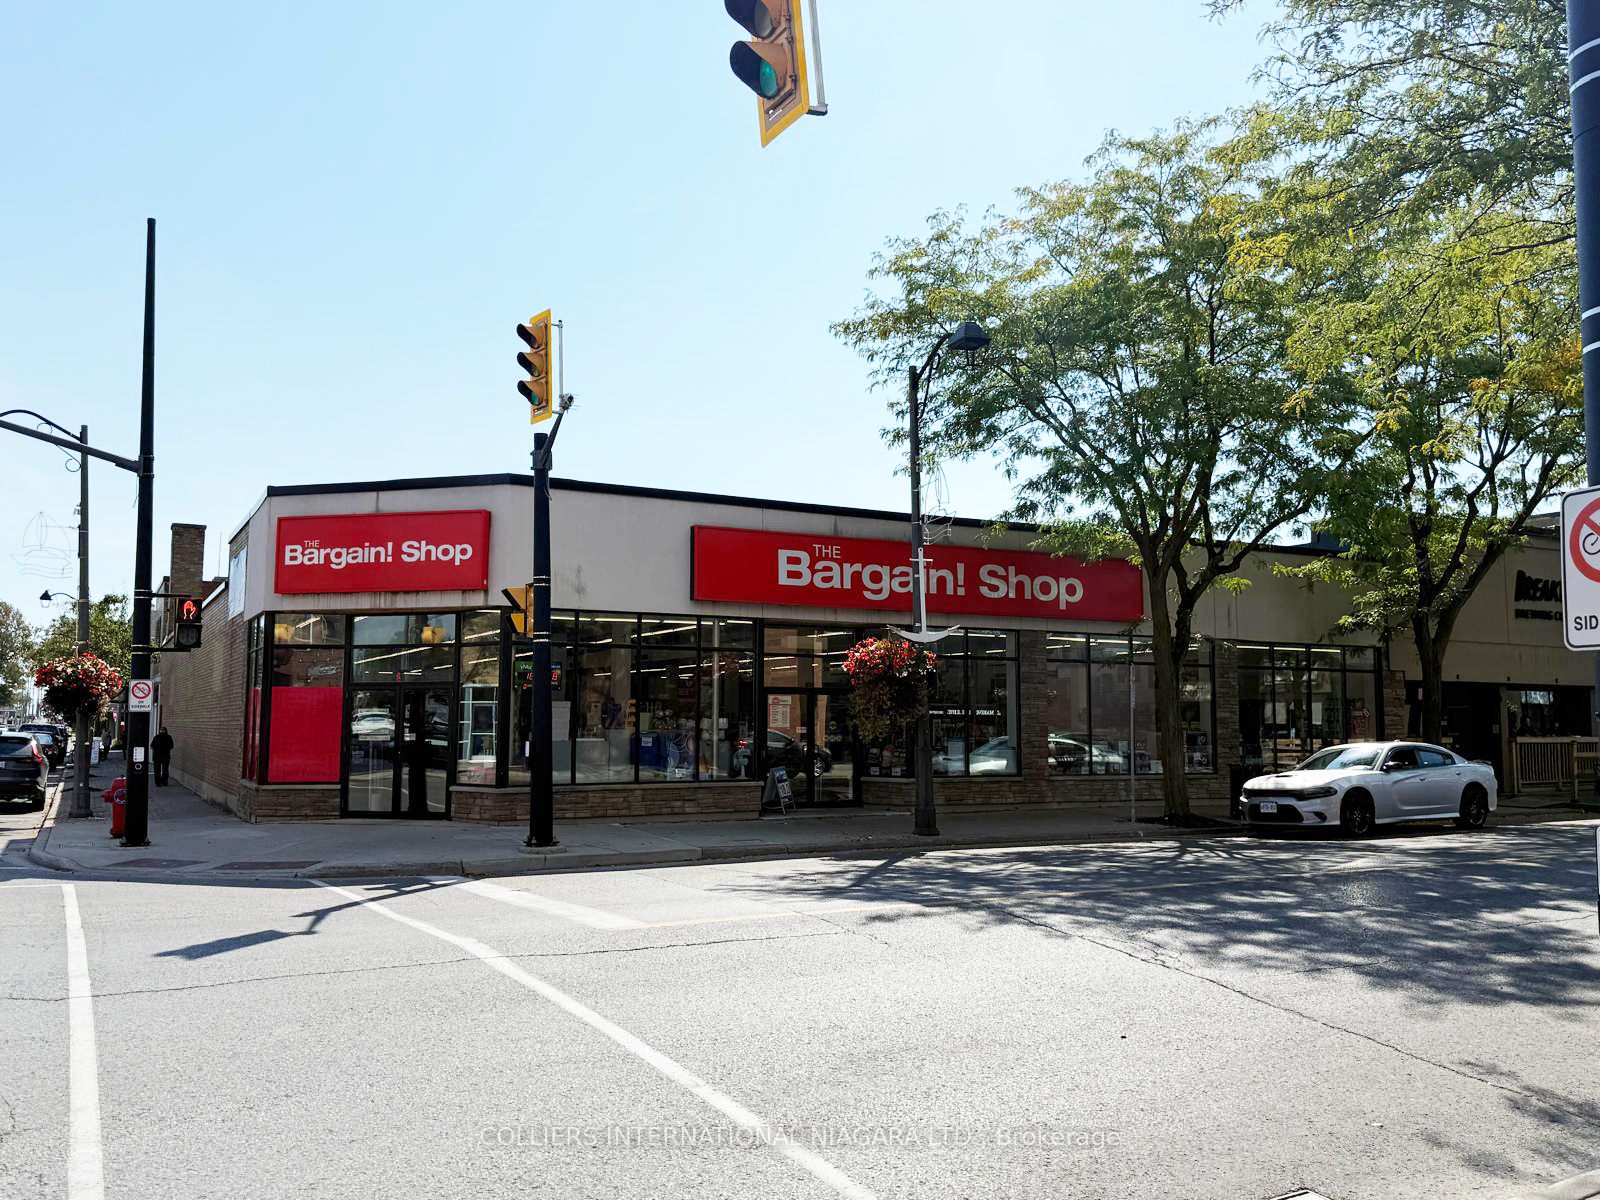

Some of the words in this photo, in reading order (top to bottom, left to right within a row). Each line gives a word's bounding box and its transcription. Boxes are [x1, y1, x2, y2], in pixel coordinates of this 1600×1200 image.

[284, 541, 393, 570] Bargain!
[401, 540, 473, 566] Shop
[304, 540, 320, 548] THE
[812, 544, 841, 559] THE
[978, 563, 1084, 610] Shop
